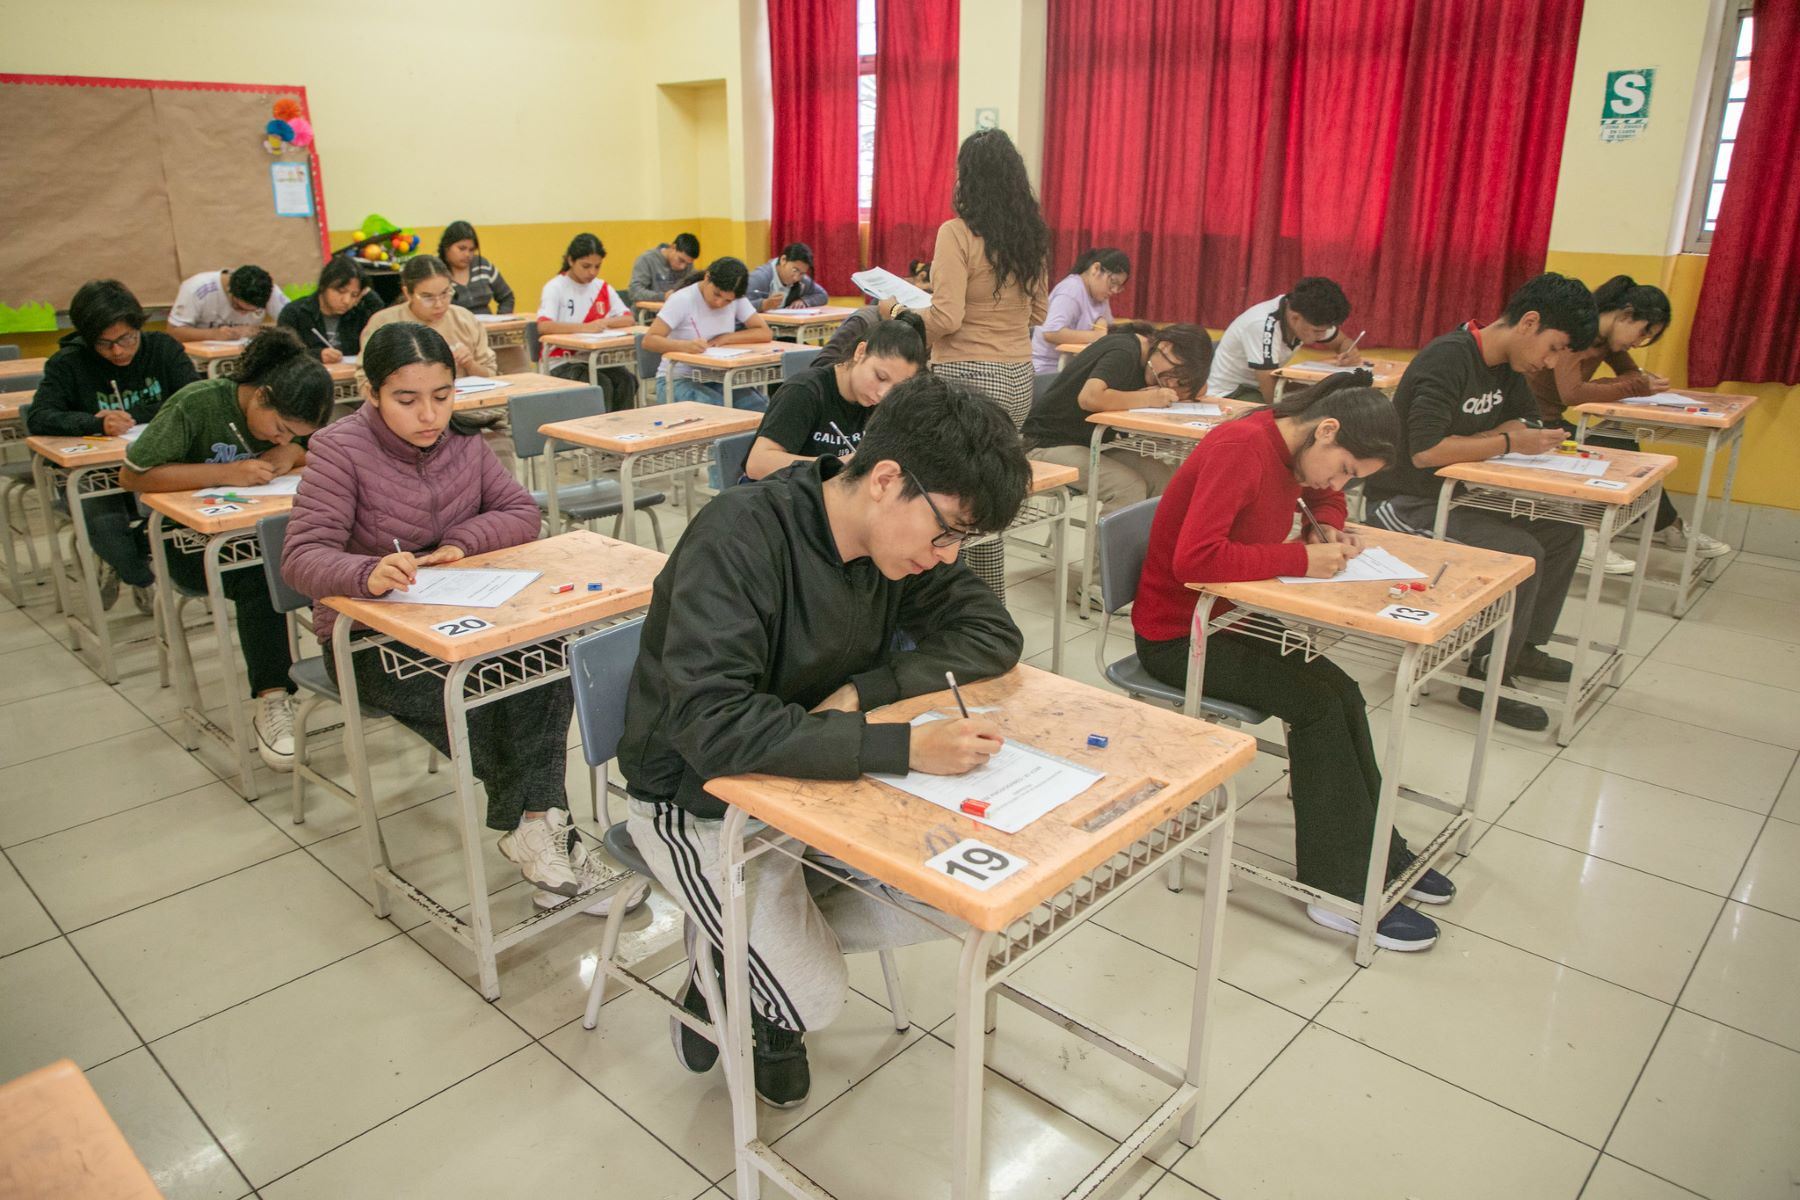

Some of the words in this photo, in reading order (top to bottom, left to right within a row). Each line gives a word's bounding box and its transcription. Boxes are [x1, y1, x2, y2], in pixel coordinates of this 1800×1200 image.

[1610, 73, 1646, 115] S
[203, 504, 239, 515] 21
[1388, 607, 1430, 621] 13
[438, 619, 487, 636] 20
[945, 847, 1011, 883] 19
